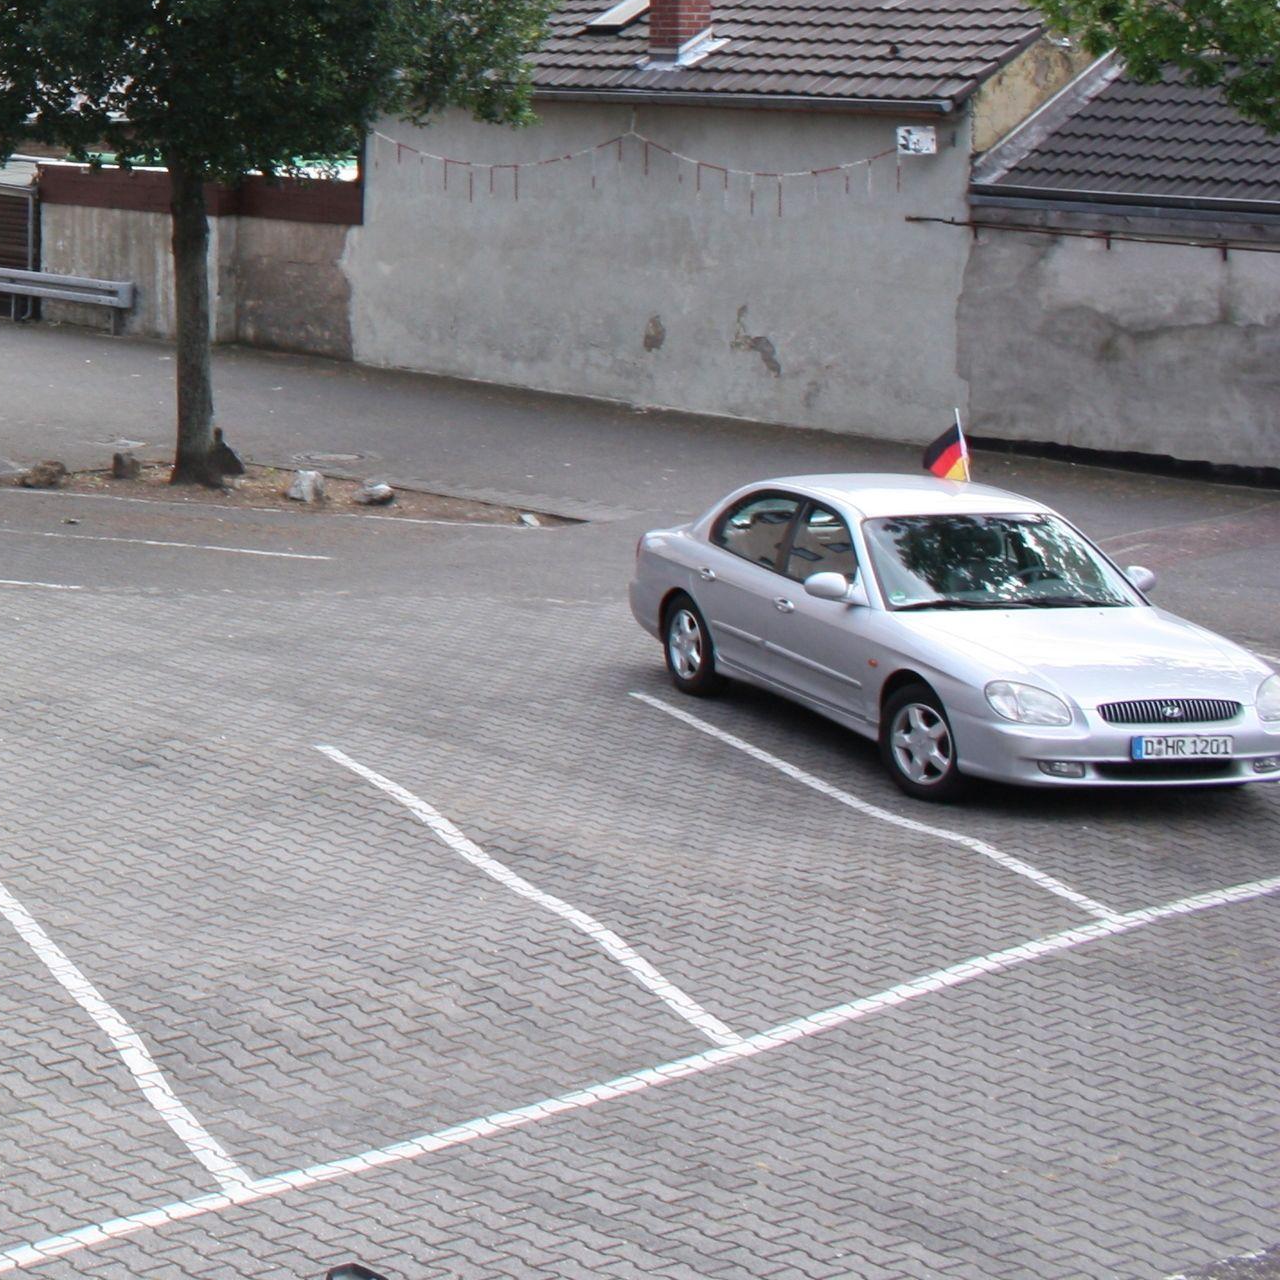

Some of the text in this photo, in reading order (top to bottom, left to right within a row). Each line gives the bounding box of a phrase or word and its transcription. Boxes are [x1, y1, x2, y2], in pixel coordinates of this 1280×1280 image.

[1144, 738, 1230, 755] D HR 1201
